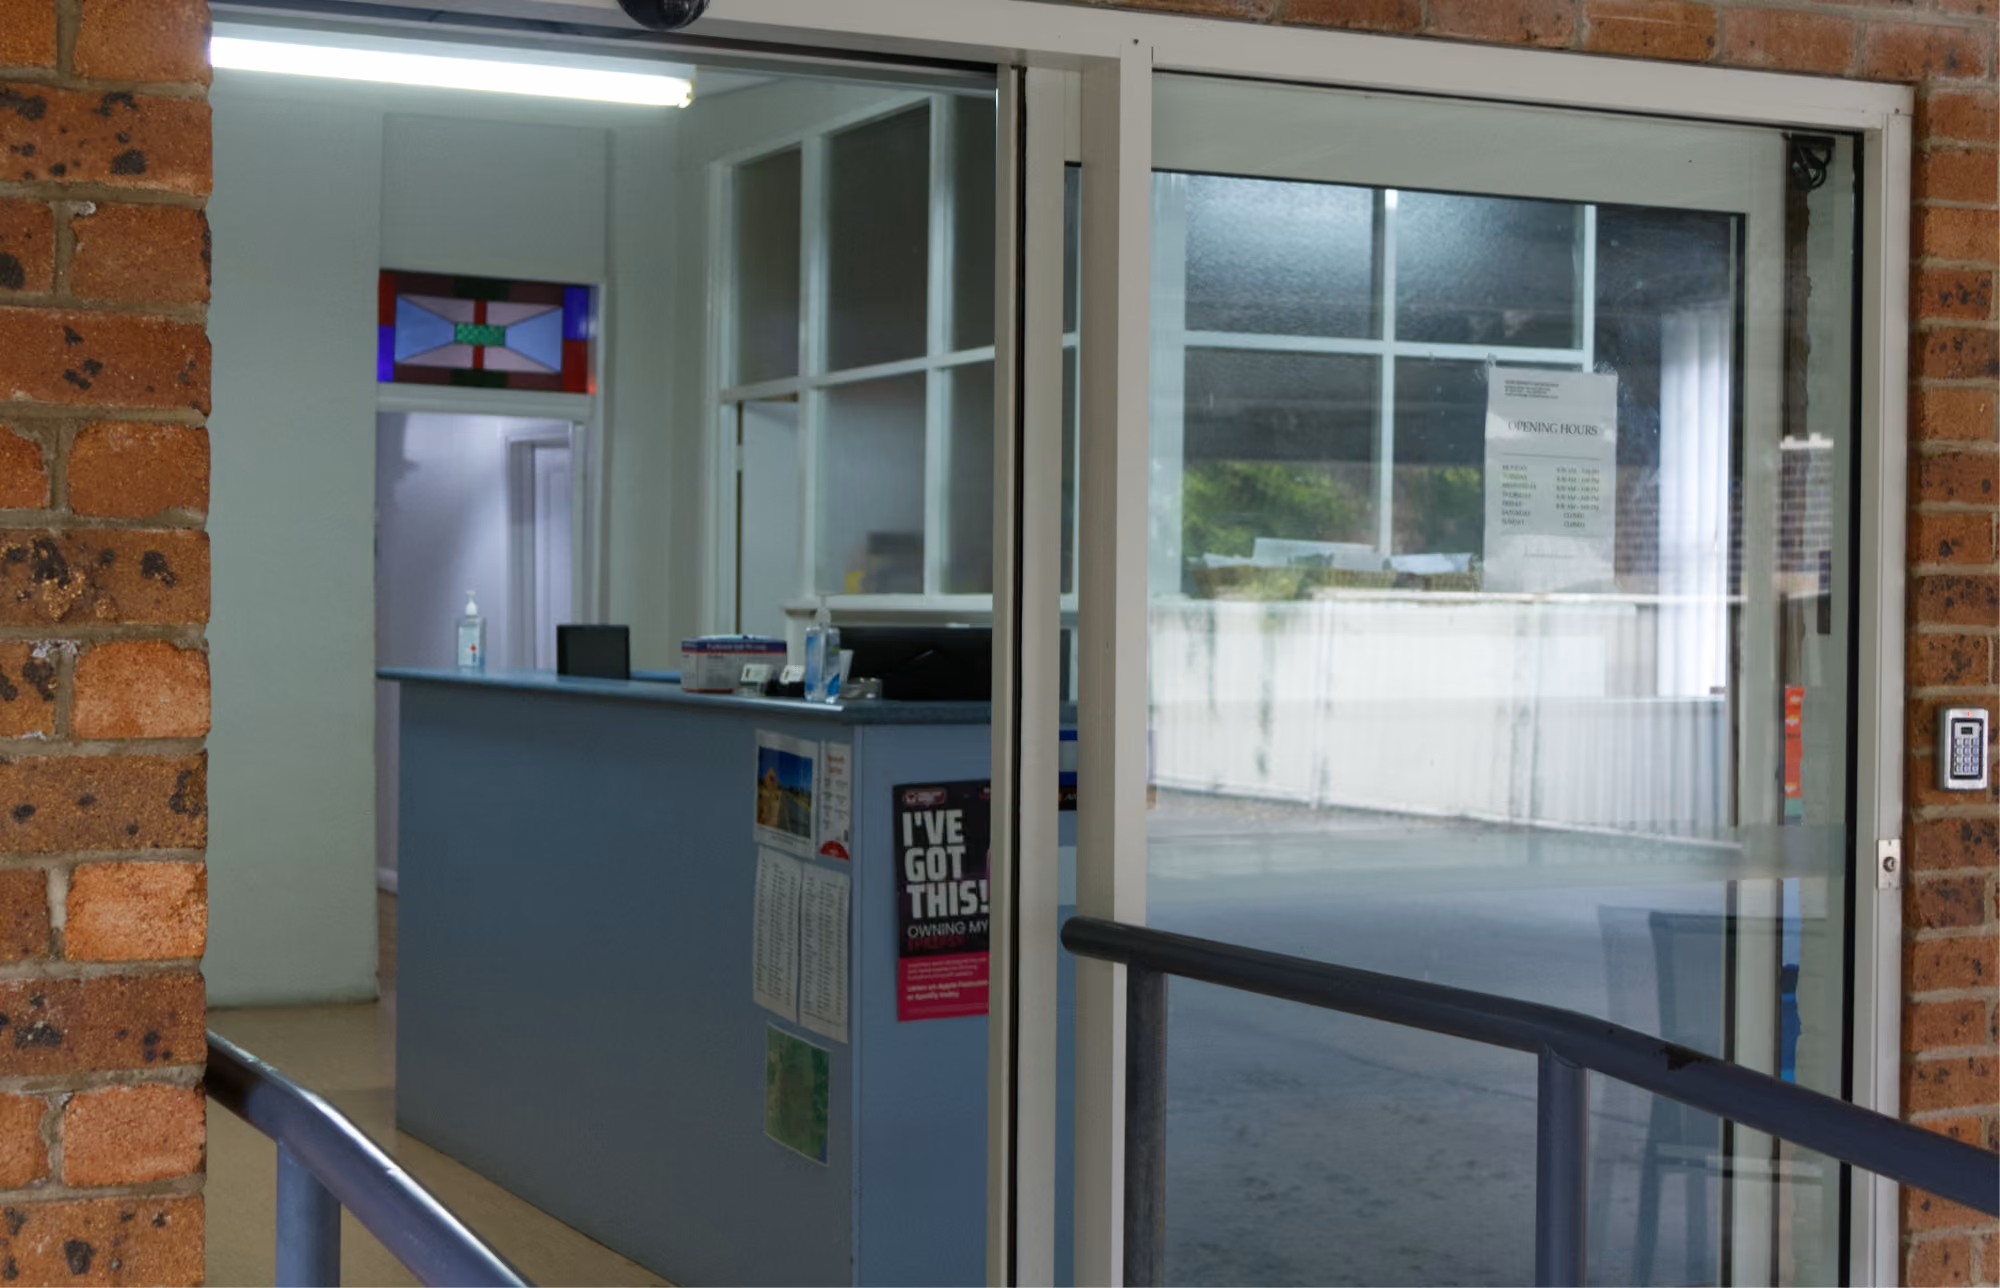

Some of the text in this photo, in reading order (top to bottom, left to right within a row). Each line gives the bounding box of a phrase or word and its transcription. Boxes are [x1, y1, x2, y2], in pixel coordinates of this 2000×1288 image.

[1508, 420, 1598, 436] OPENING HOURS
[902, 809, 964, 847] I'VE
[904, 845, 966, 883] GOT
[906, 880, 990, 919] THIS!
[907, 919, 988, 939] OWNING MY
